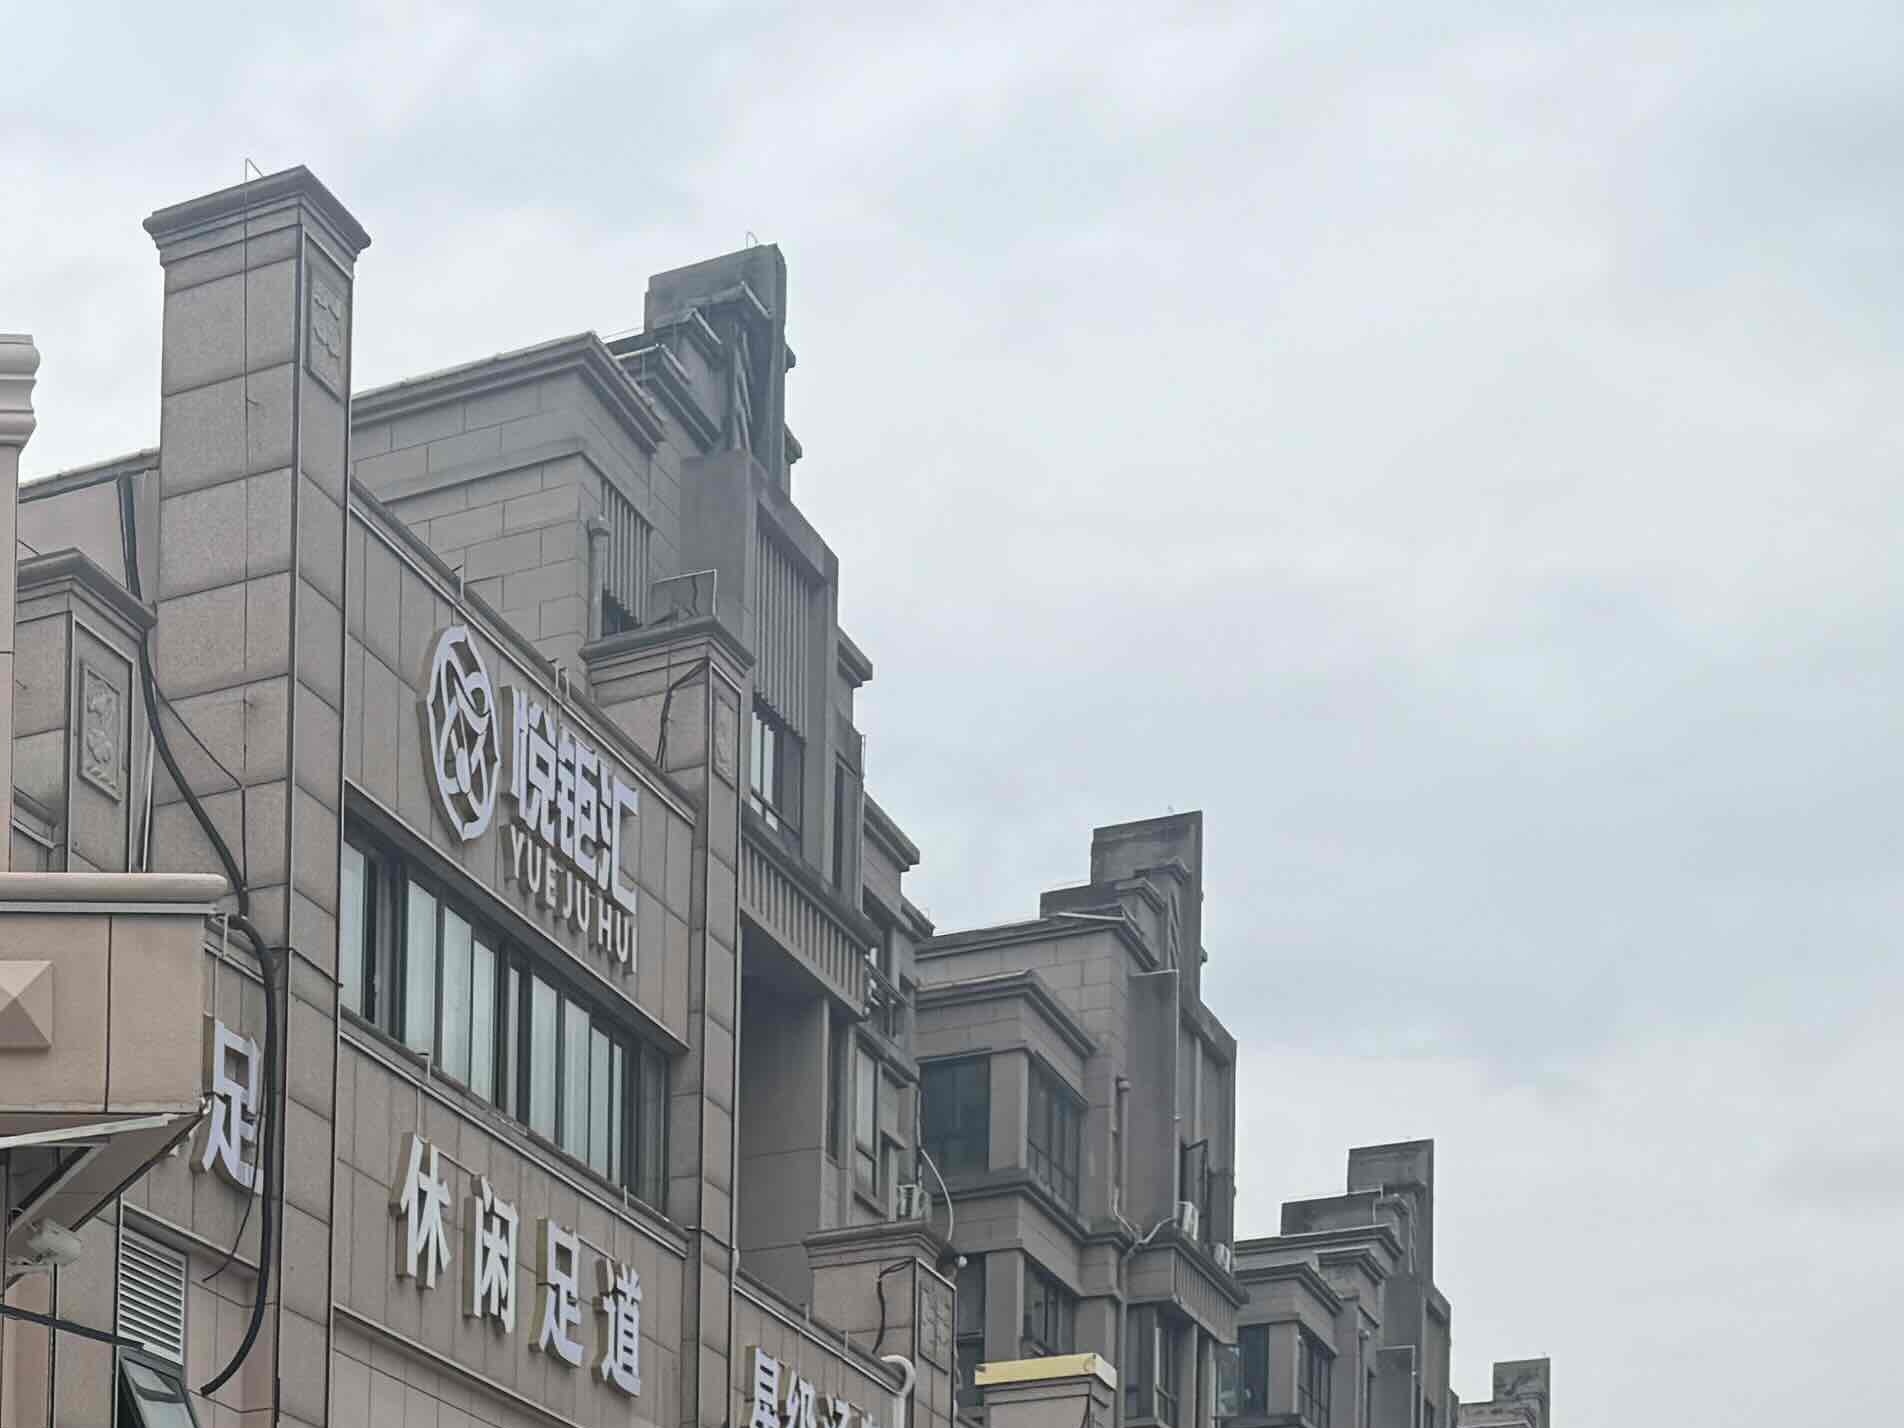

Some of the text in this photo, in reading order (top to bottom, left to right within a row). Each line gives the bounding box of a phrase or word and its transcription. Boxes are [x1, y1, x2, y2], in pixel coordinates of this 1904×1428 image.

[504, 687, 639, 915] 悦钜汇
[202, 1016, 265, 1196] 足
[394, 1132, 642, 1397] 休闲足道
